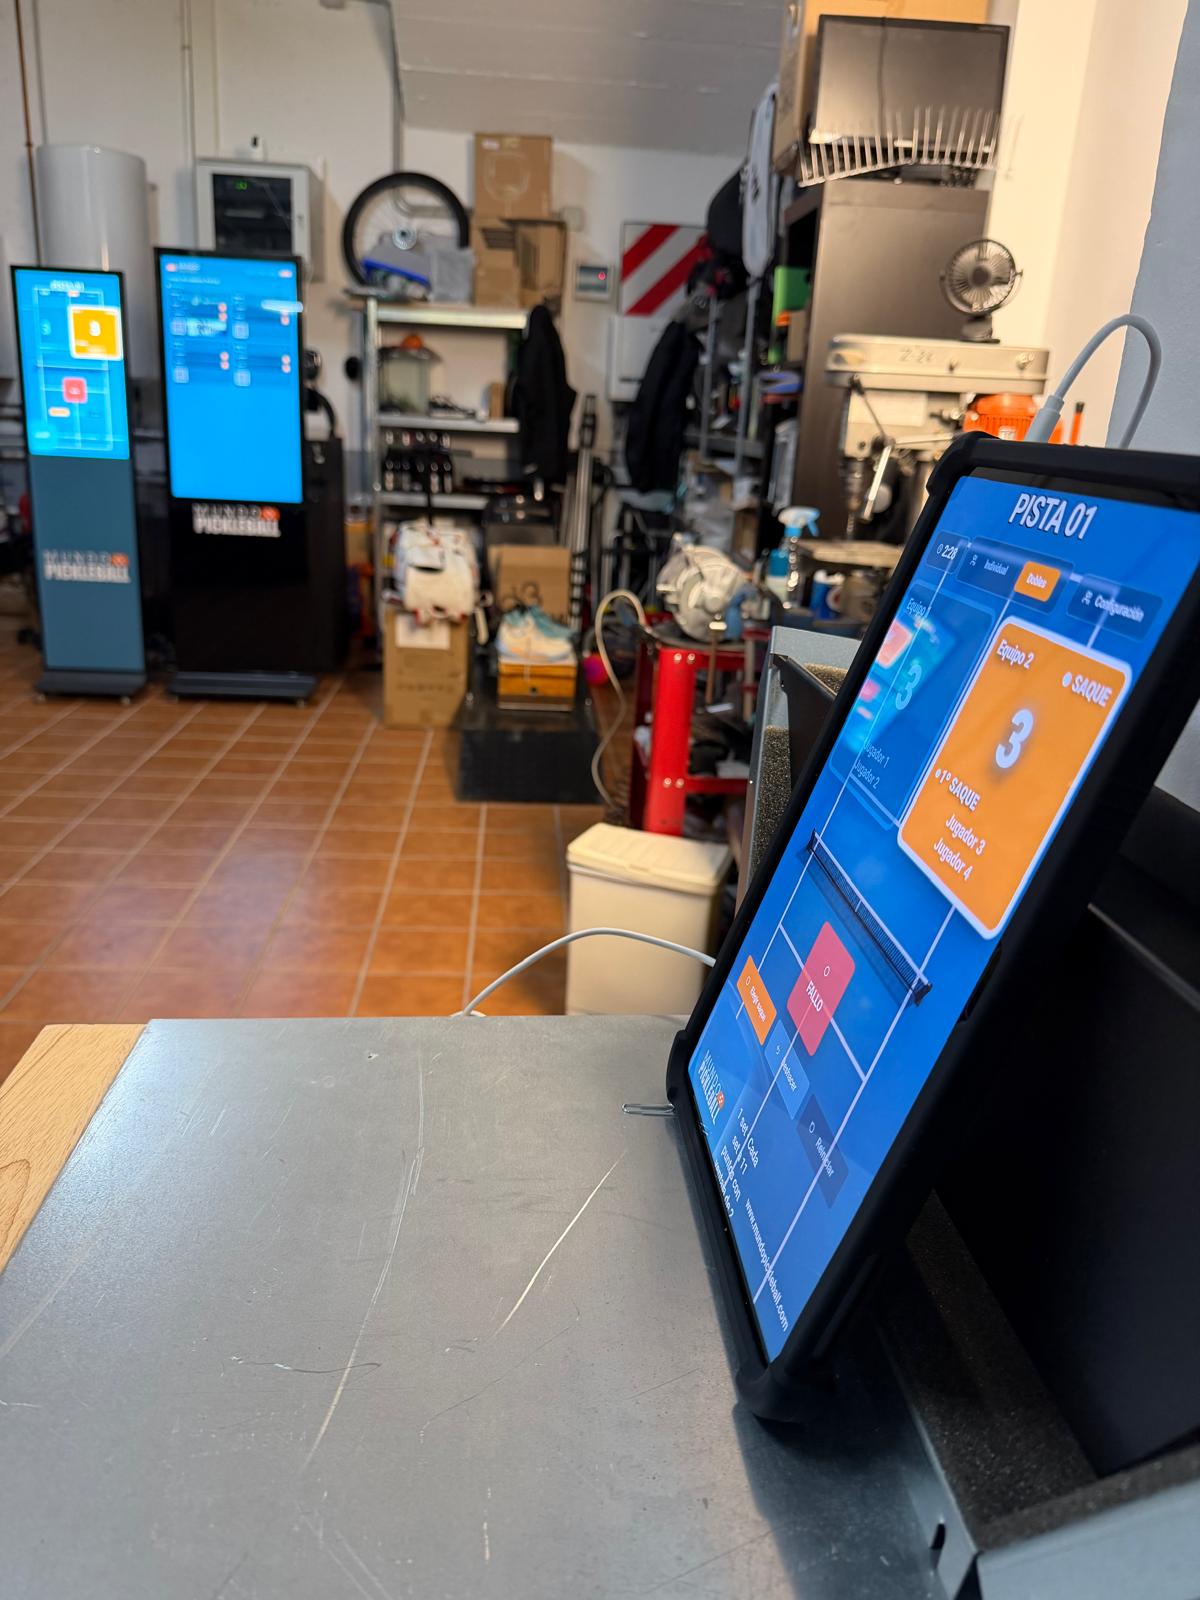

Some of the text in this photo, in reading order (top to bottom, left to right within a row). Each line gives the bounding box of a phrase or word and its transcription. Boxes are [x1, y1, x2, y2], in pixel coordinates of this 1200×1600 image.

[1008, 493, 1098, 540] PISTA 01
[941, 544, 958, 560] 2:28
[983, 559, 1009, 576] Individual
[1026, 573, 1047, 589] Dobles
[906, 598, 926, 617] Equipo
[996, 639, 1035, 669] Equipo 2
[895, 663, 922, 710] 3
[1071, 674, 1113, 707] SAQUE
[995, 709, 1034, 769] 3
[854, 759, 881, 790] Jugador 2
[883, 758, 890, 768] 1
[949, 777, 981, 811] SAQUE
[945, 814, 986, 855] Jugador 3
[933, 837, 974, 881] Jugador 4
[805, 980, 824, 1012] FALLO
[704, 1049, 722, 1096] MUNDO
[780, 1058, 798, 1092] eshacer
[698, 1061, 720, 1126] PICKLEBALL
[732, 1135, 741, 1154] set
[740, 1157, 748, 1175] 11
[738, 1108, 759, 1168] 1 set Cada
[721, 1145, 741, 1203] puntos con
[745, 1198, 789, 1332] www.mundopicleball.com
